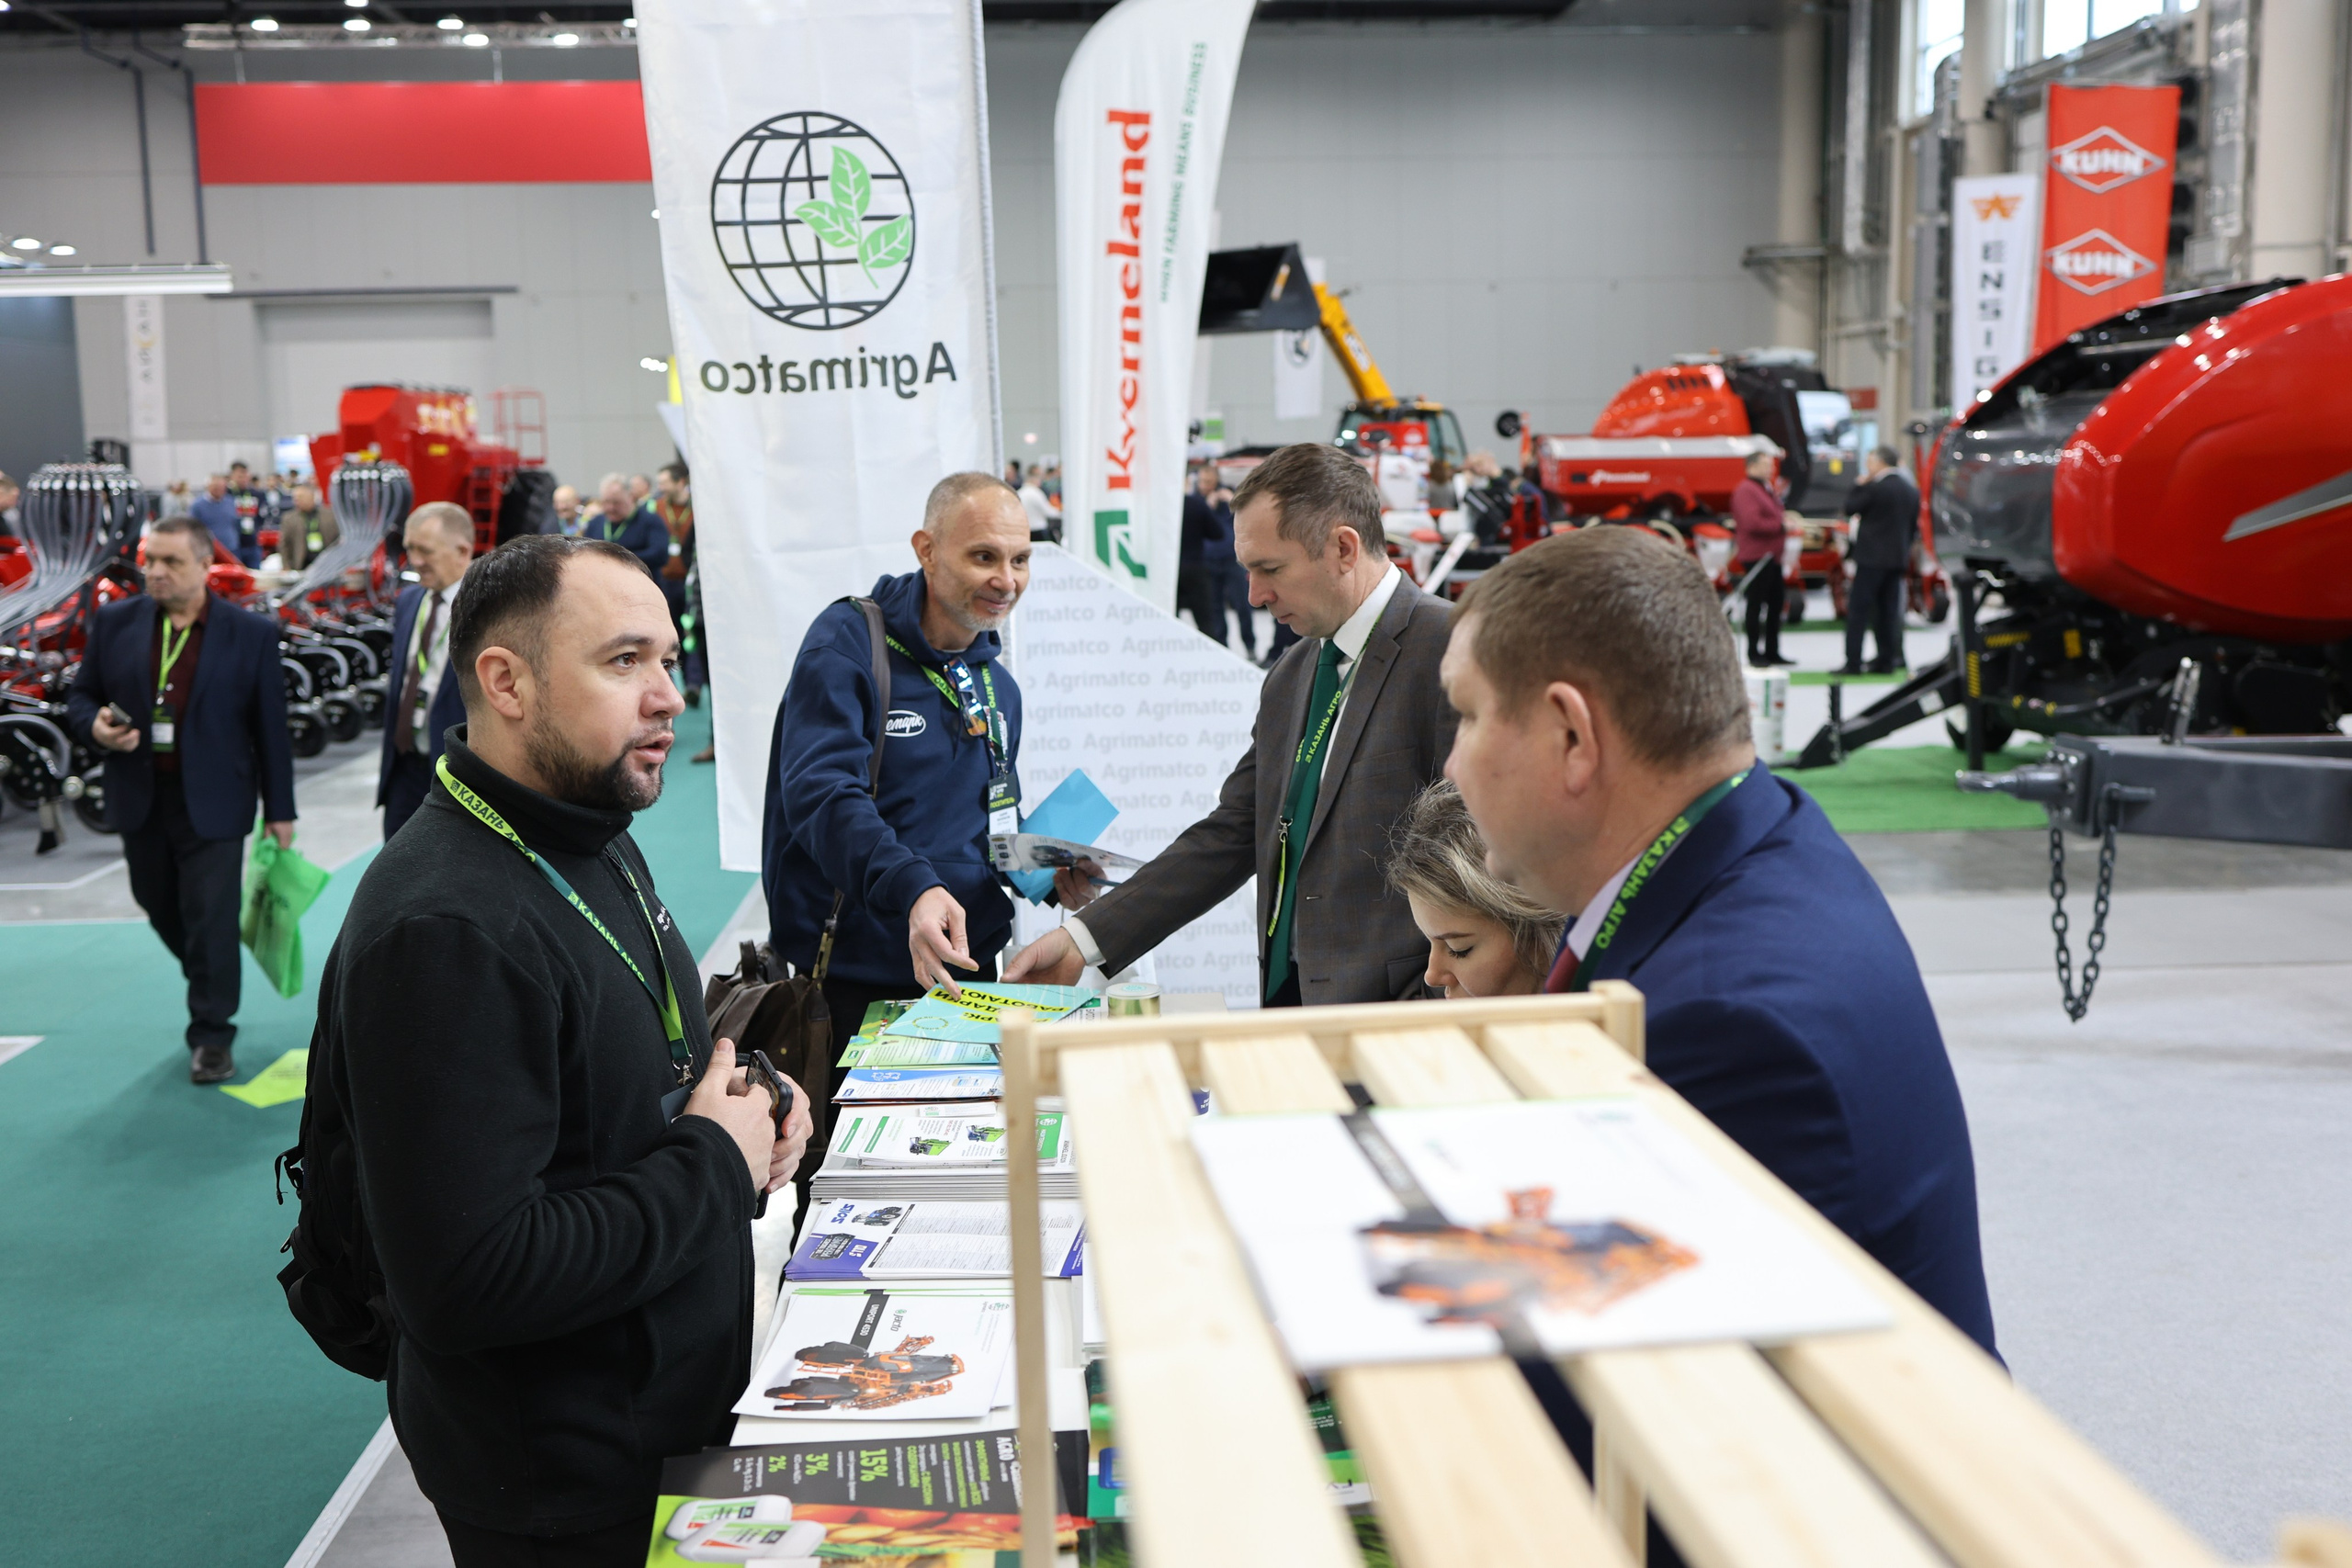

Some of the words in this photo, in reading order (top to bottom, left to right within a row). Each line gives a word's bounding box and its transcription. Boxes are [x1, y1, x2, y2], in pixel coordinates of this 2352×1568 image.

[1175, 121, 1193, 177] MEANS
[2060, 149, 2145, 176] KUHN
[2052, 250, 2136, 278] KUHN
[1107, 109, 1151, 490] Kverneland
[1974, 240, 2006, 395] ENSIG
[1030, 575, 1100, 591] imatco
[1026, 604, 1095, 622] imatco
[1121, 635, 1214, 659] Agrimatc
[1045, 671, 1151, 693] Agrimatco
[985, 685, 997, 708] АГРО
[1136, 699, 1242, 722] Agrimatco
[886, 715, 923, 734] емарк
[1308, 716, 1330, 756] КАЗАНЬ
[1327, 690, 1342, 716] АГРО
[1082, 732, 1189, 754] Agrimatco
[1101, 761, 1207, 784] Agrimatco
[458, 787, 504, 829] КАЗАНЬ
[1620, 830, 1676, 899] КАЗАНЬ
[1595, 899, 1626, 949] АГРО
[577, 901, 620, 952] КАЗАНЬ
[620, 951, 645, 982] АГРО
[865, 1303, 880, 1324] UNIPORT
[768, 1455, 787, 1473] 2%
[805, 1452, 829, 1476] 3%
[860, 1449, 888, 1482] 15%
